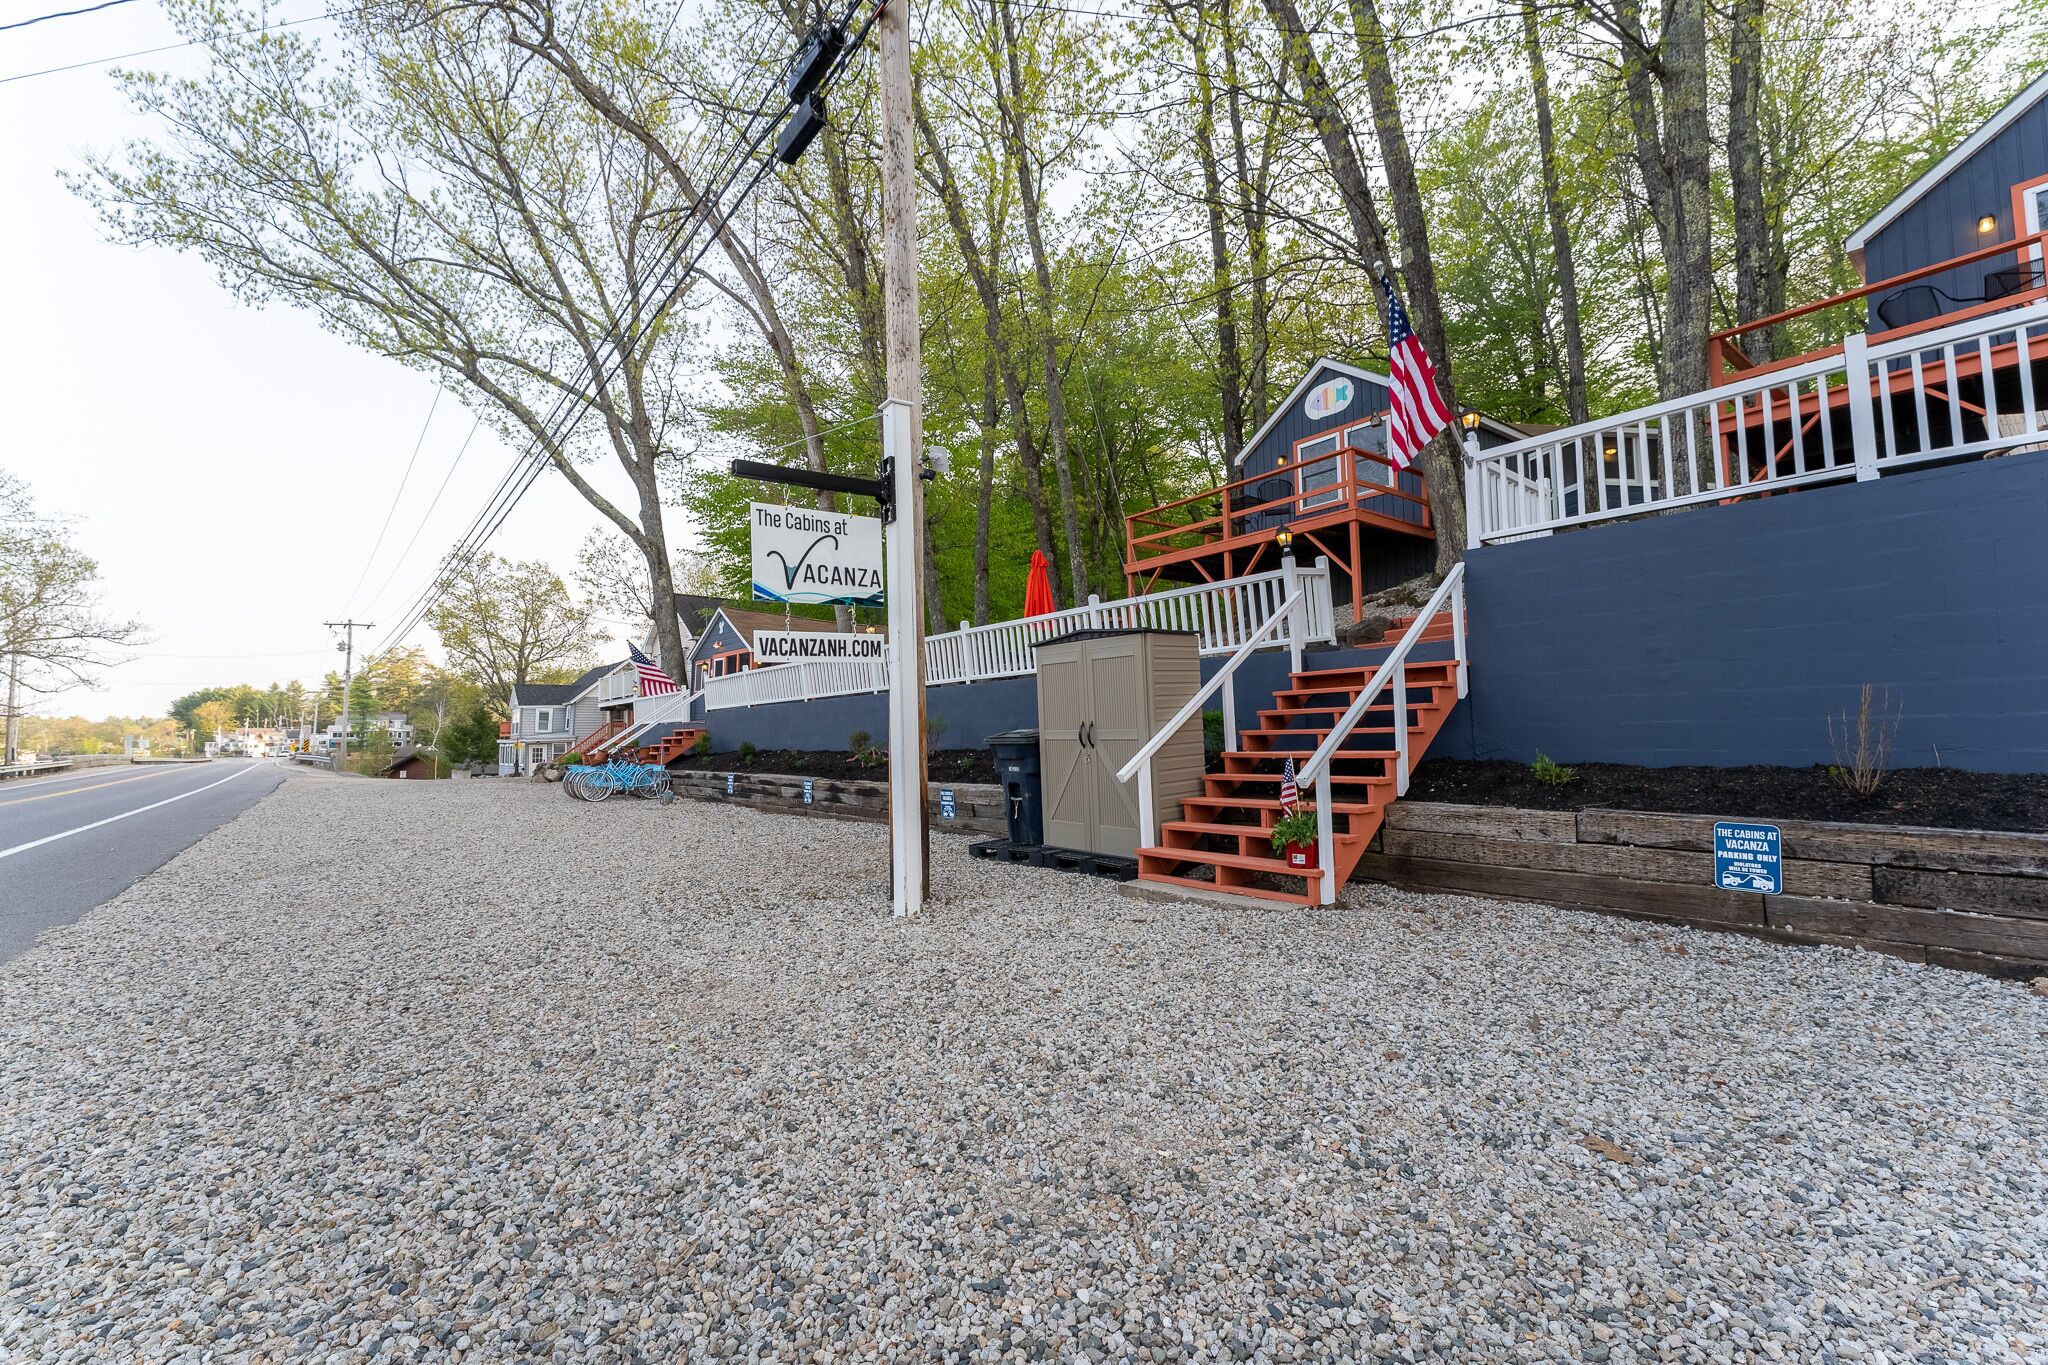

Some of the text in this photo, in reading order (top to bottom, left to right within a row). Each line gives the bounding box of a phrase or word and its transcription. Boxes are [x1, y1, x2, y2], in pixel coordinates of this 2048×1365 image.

[756, 508, 848, 536] The Cabins at
[766, 534, 882, 590] VACANZA
[758, 637, 882, 658] VACANZANH.COM
[1717, 828, 1778, 841] THE CABINS AT
[1725, 839, 1769, 852] VACANZA
[1717, 851, 1778, 863] PARKING ONLY
